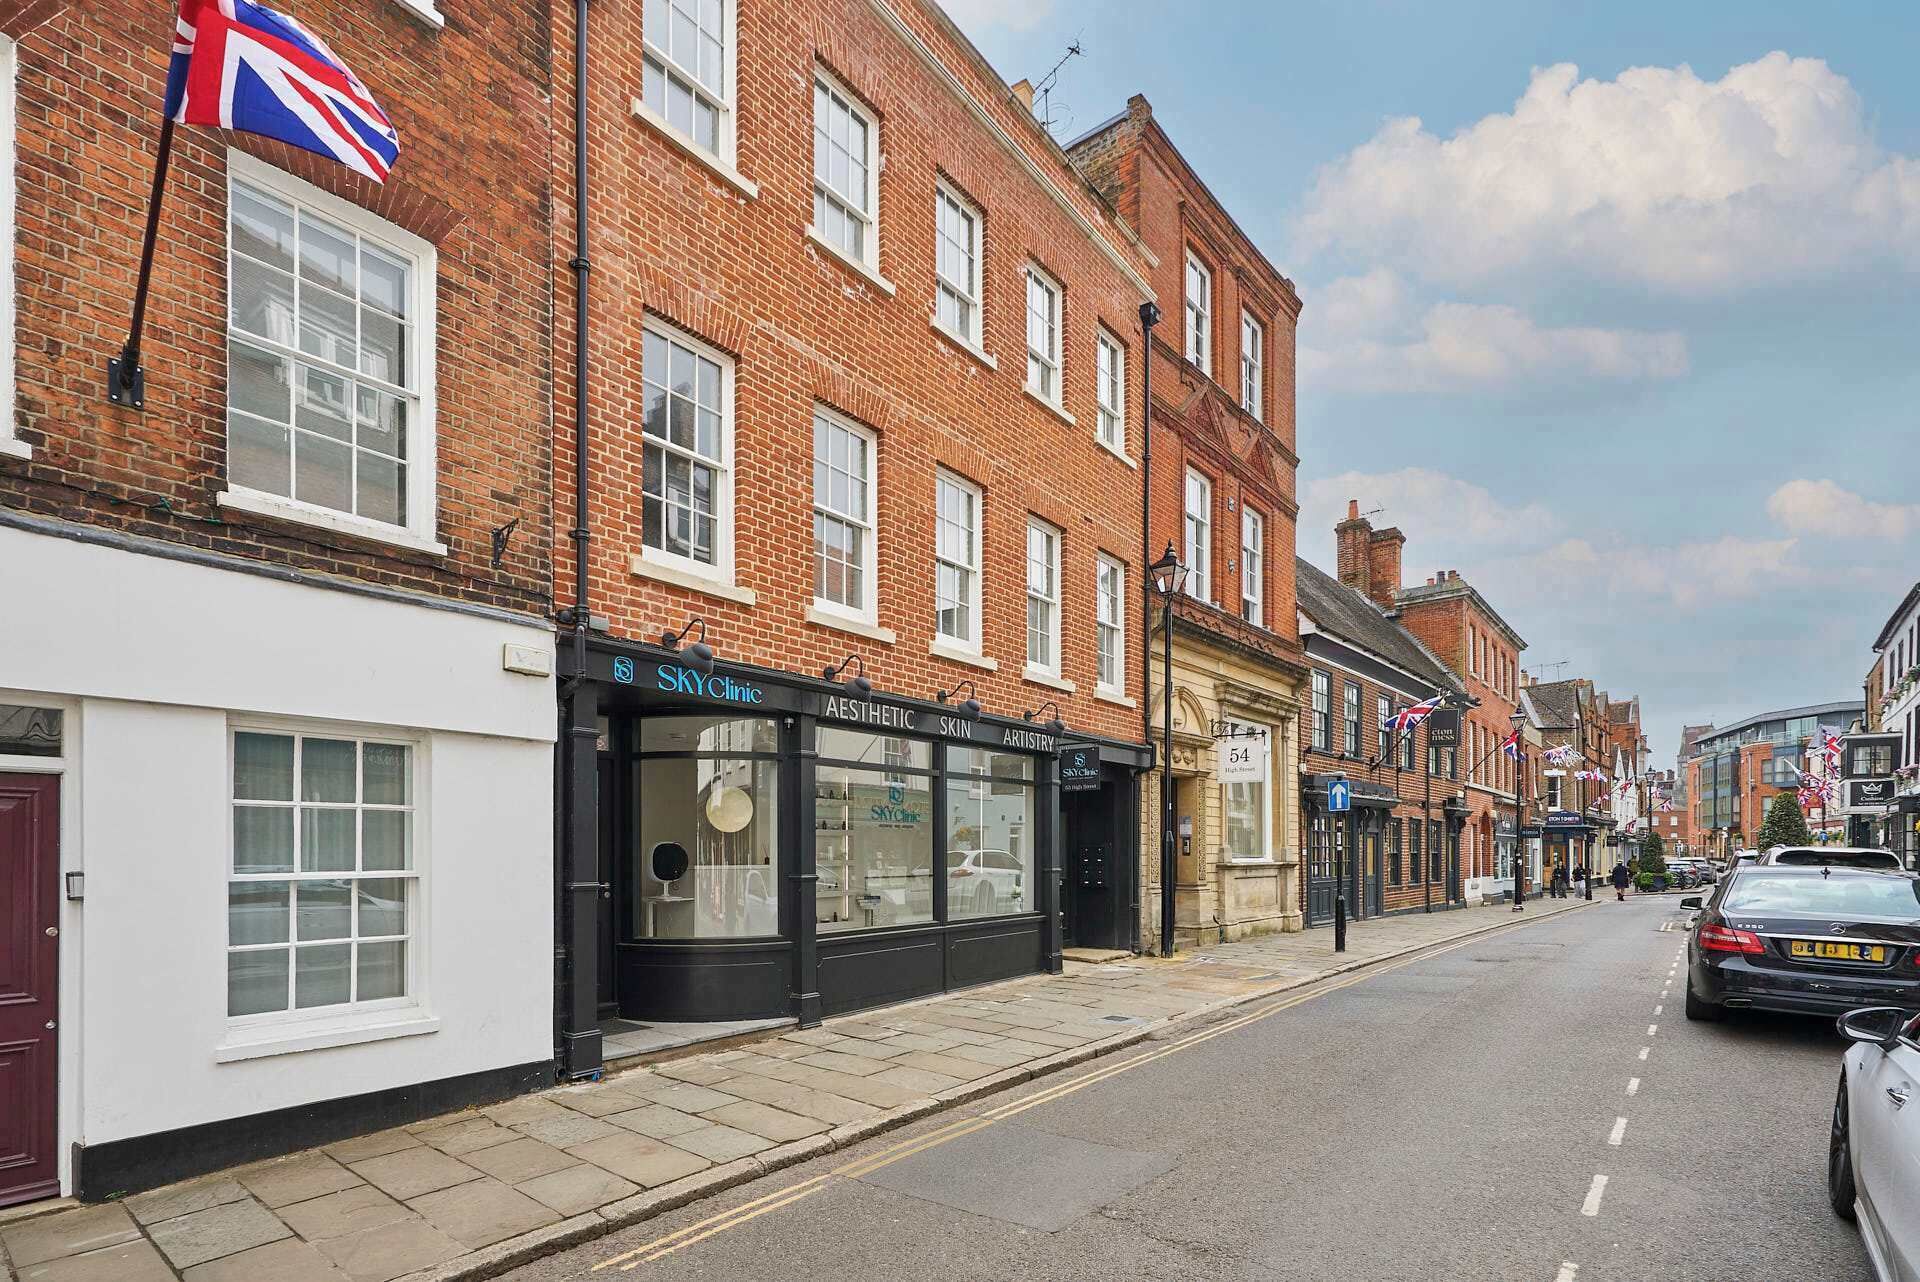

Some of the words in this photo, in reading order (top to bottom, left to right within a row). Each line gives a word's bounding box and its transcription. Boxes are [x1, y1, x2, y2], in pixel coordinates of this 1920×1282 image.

[656, 663, 763, 704] SKYClinic
[825, 695, 915, 730] AESTHETIC
[939, 716, 971, 739] SKIN
[1003, 727, 1054, 752] ARTISTRY
[1230, 747, 1250, 763] 54
[1062, 768, 1098, 777] SKYClinic
[871, 804, 920, 822] SKYClinic
